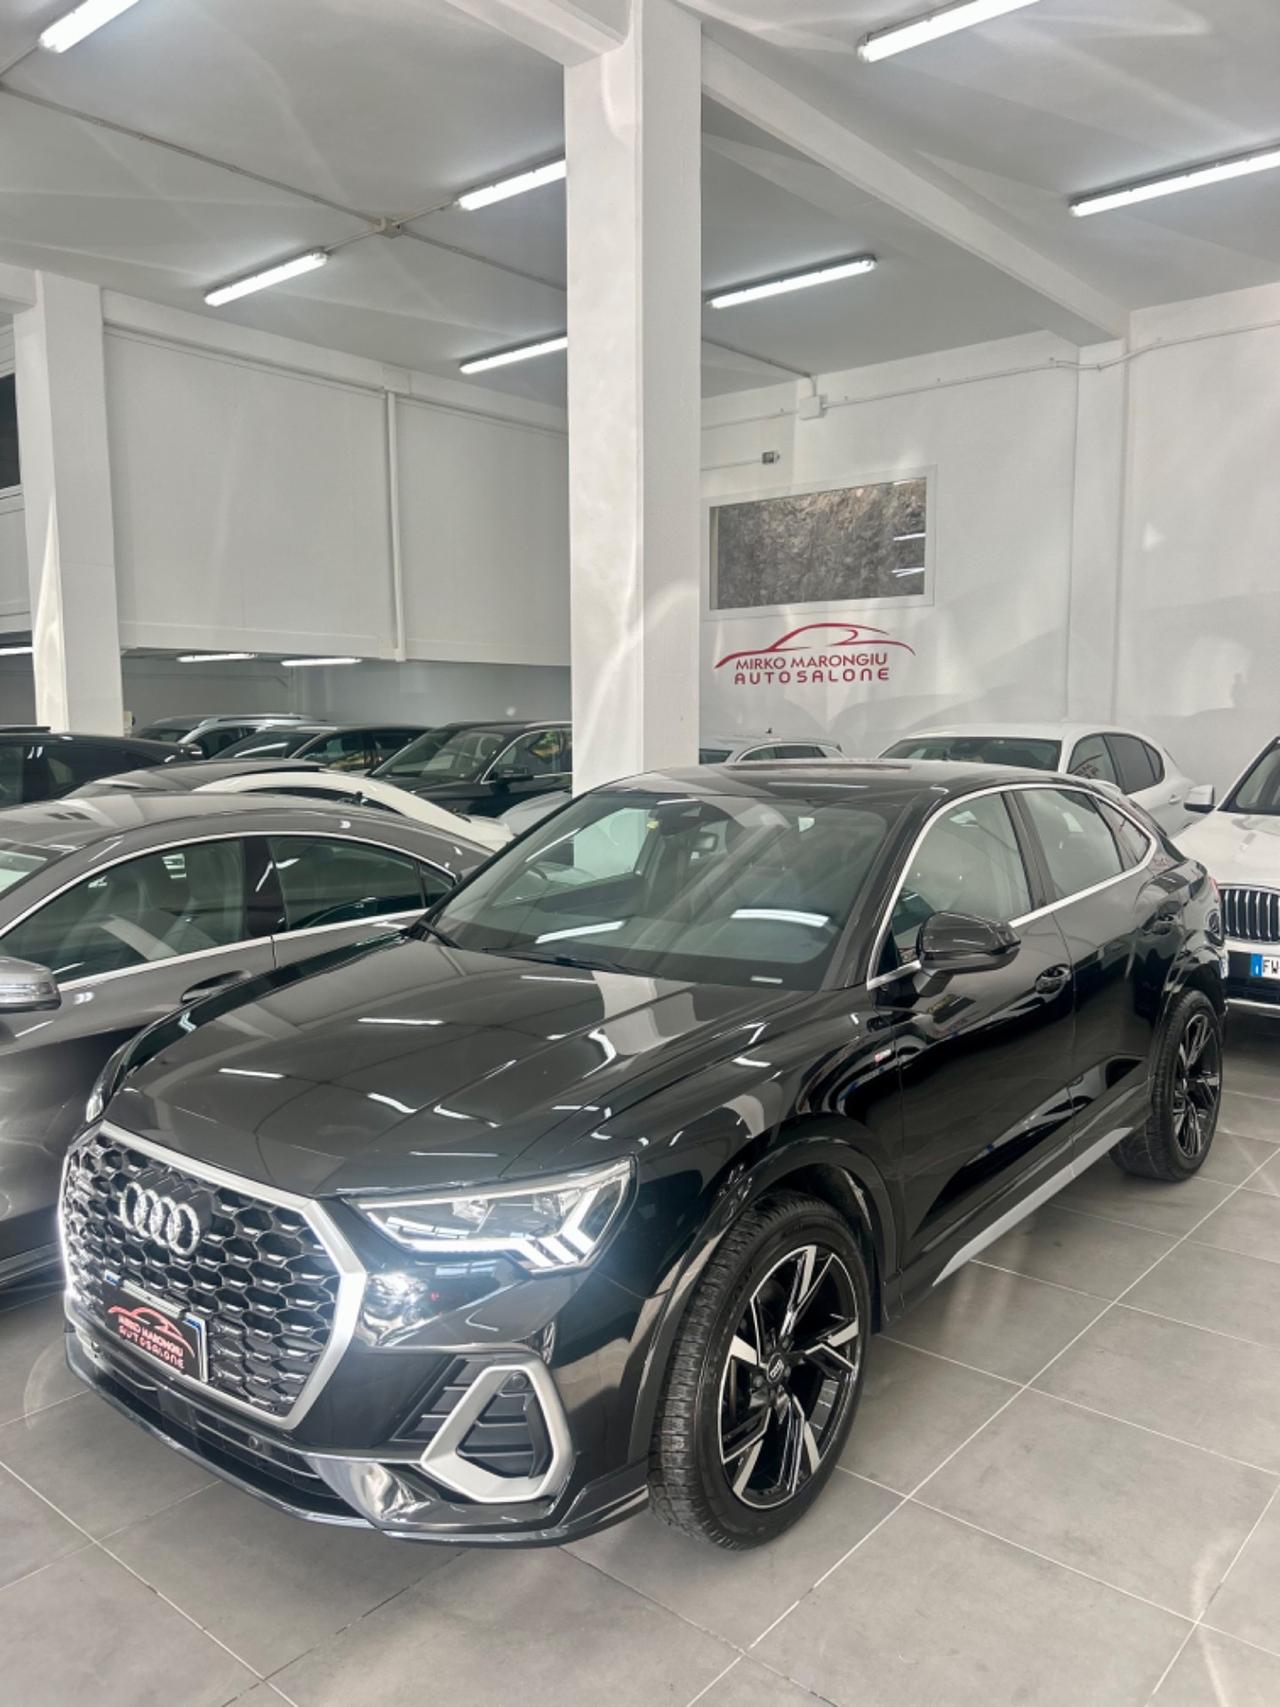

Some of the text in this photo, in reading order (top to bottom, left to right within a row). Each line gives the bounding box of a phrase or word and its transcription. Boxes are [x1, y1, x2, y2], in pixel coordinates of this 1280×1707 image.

[736, 653, 887, 670] MIRKO MARONGIU
[734, 668, 889, 685] AUTOSALONE
